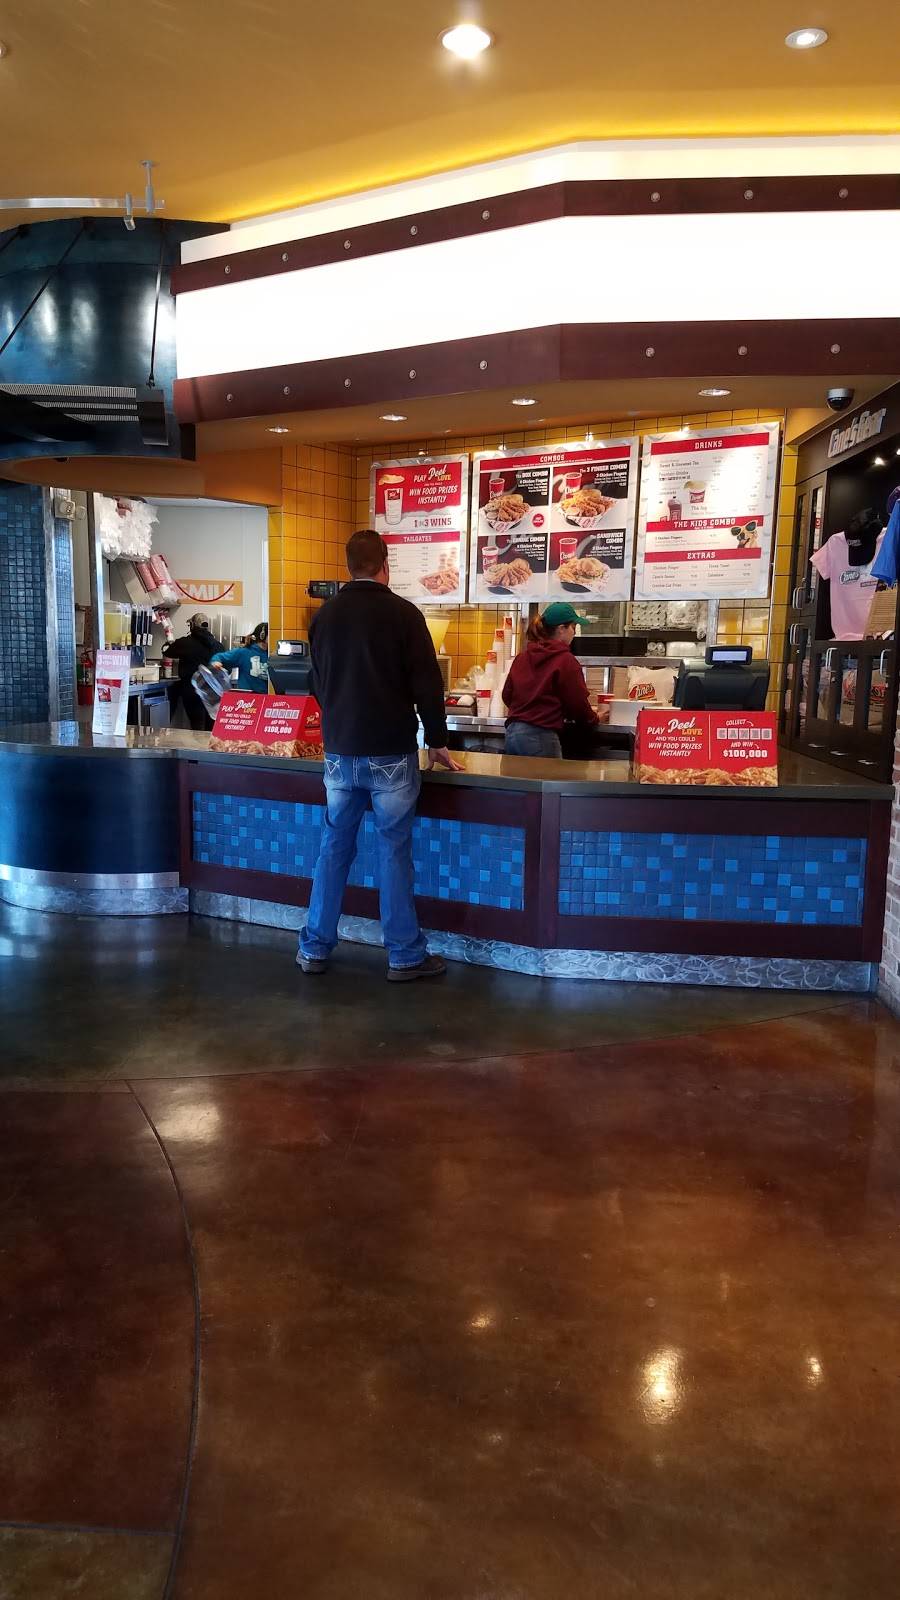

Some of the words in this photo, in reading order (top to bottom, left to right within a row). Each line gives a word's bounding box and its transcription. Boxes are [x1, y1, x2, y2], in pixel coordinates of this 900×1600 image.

[695, 440, 723, 449] DRINKS
[540, 454, 565, 462] COMBOS
[428, 464, 447, 481] Peel
[437, 473, 452, 481] LOVE
[413, 474, 427, 483] PLAY
[422, 487, 437, 495] FOOD
[438, 485, 458, 494] PRIZES
[417, 496, 446, 505] INSTANTLY
[430, 517, 452, 526] WINS
[674, 520, 688, 528] THE
[690, 519, 708, 527] KIDS
[709, 518, 736, 526] COMBO
[403, 535, 432, 543] TAILGATES
[112, 654, 129, 666] WIN
[235, 699, 255, 711] Peel
[647, 726, 665, 735] PLAY
[668, 717, 696, 733] Peel
[682, 728, 703, 736] LOVE
[726, 719, 746, 727] COLLECT
[264, 726, 292, 735] $100,000
[723, 749, 768, 759] $100,000
